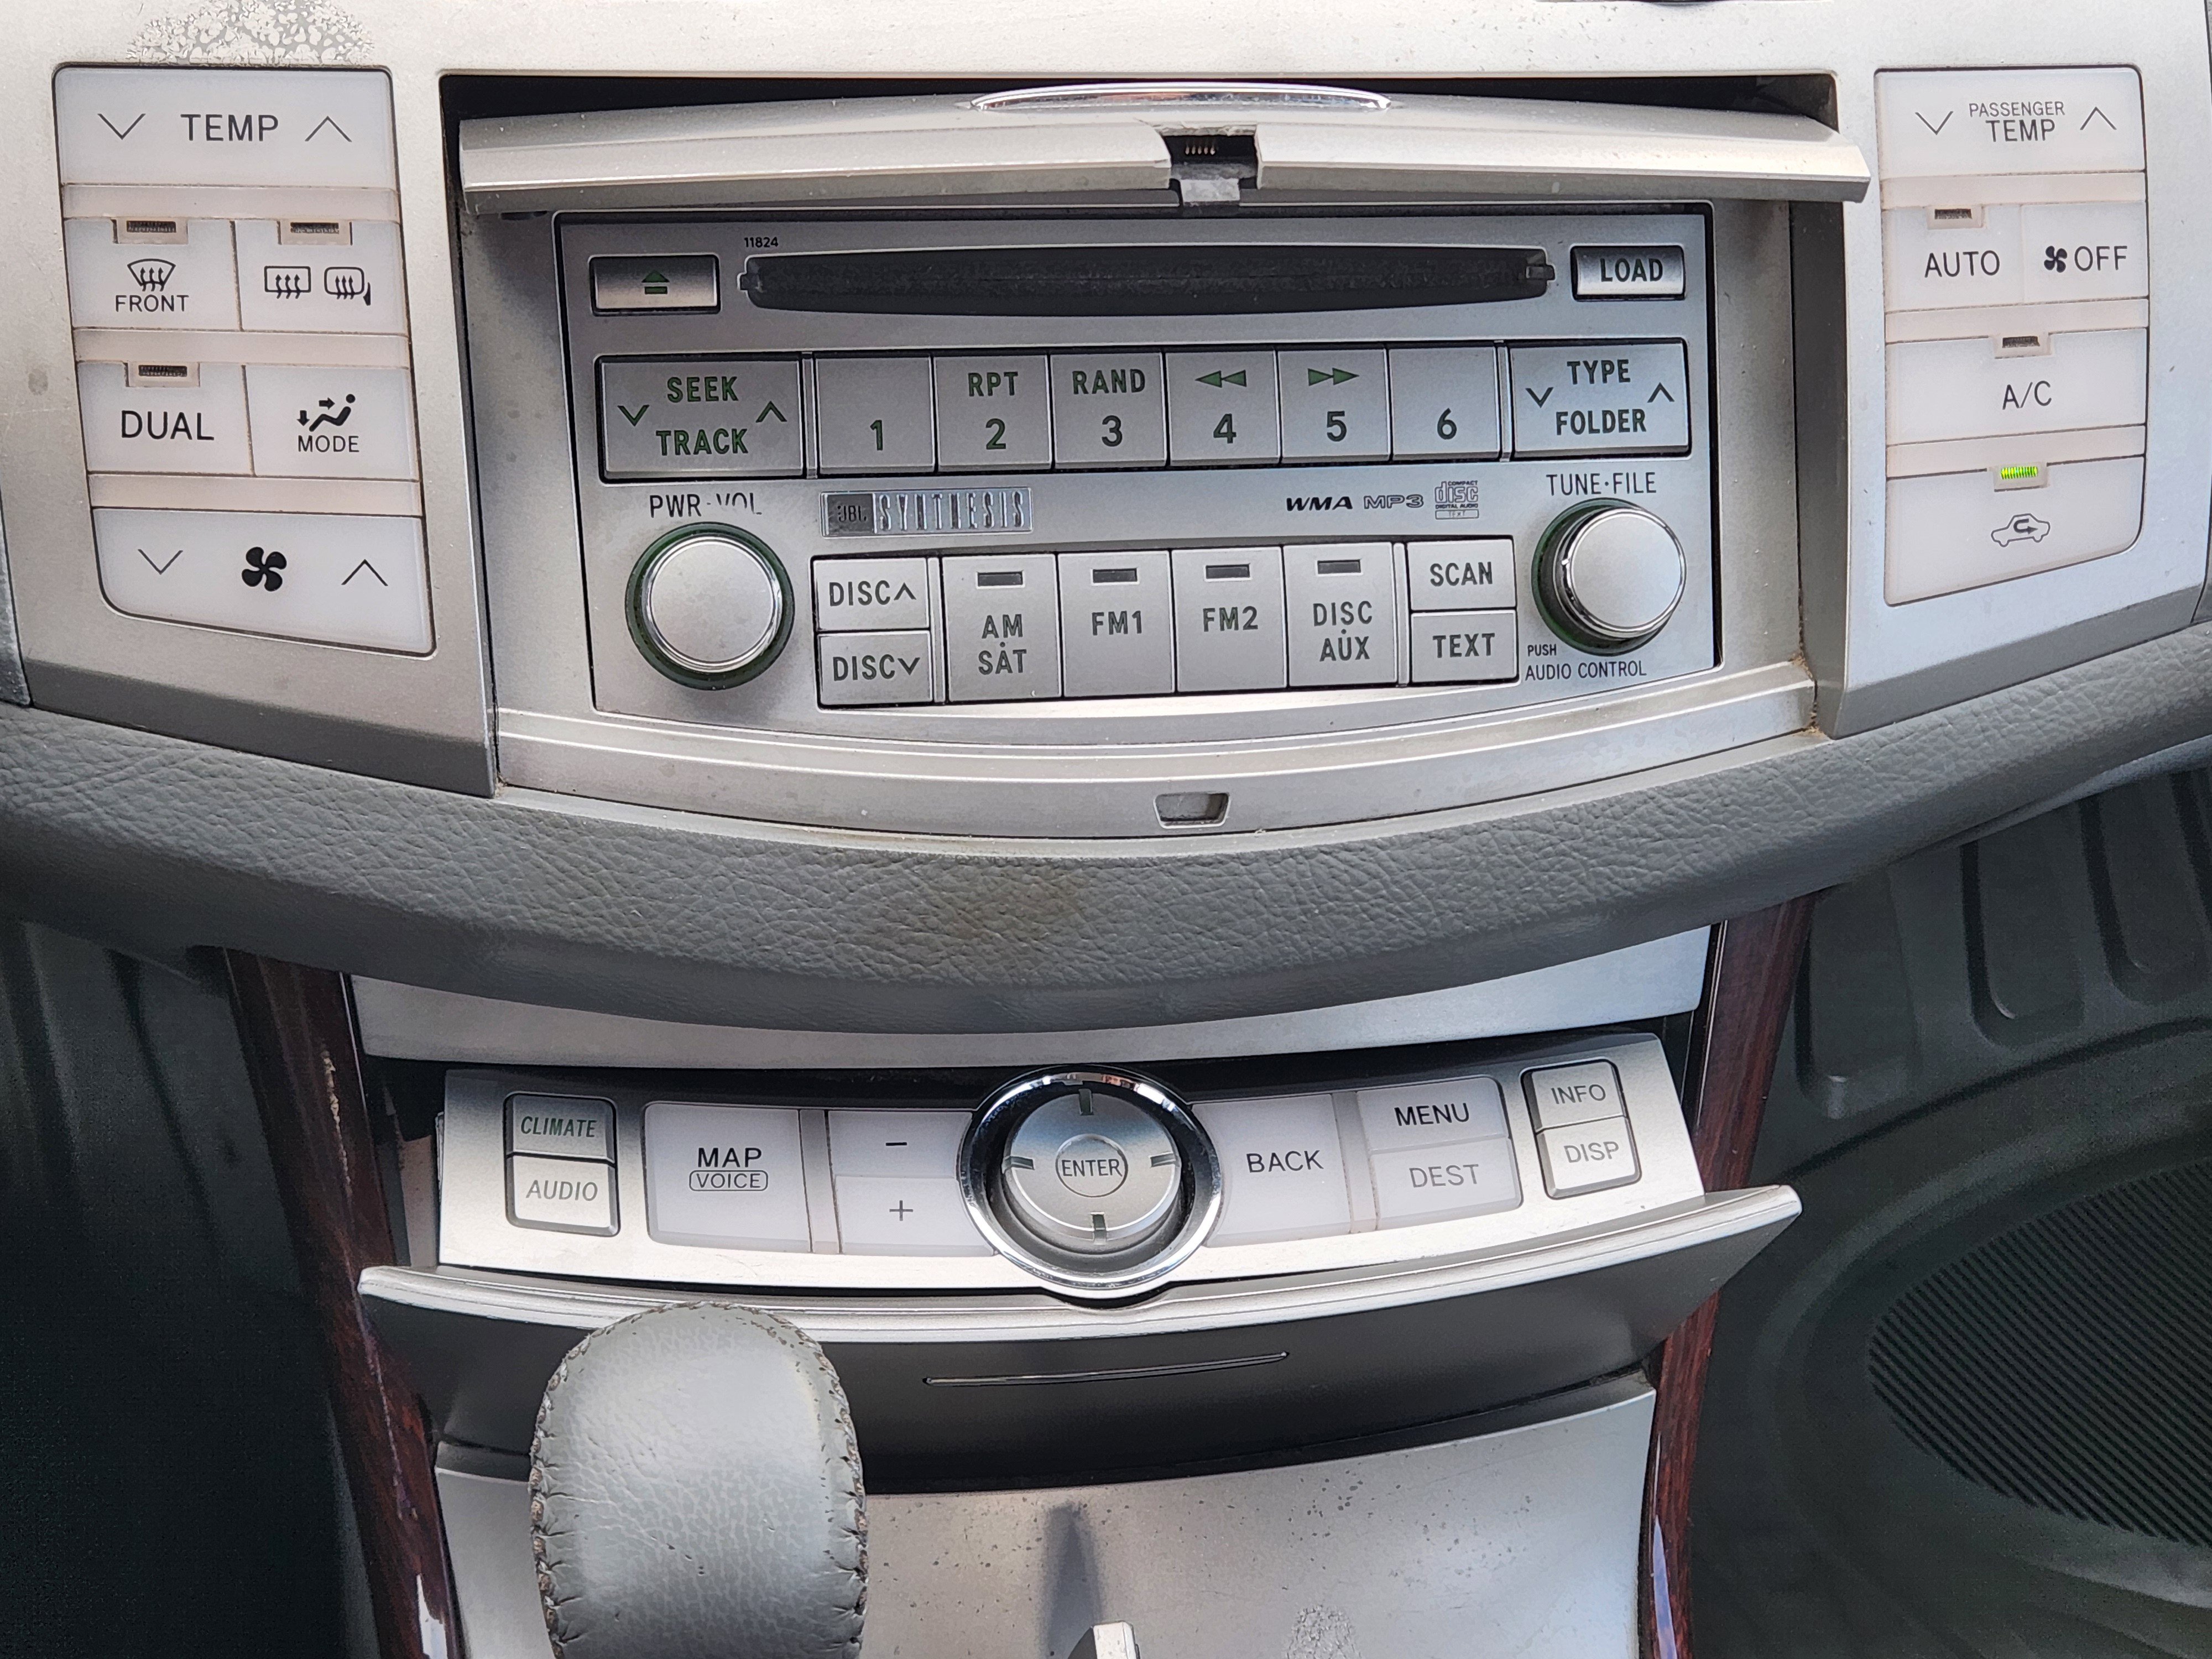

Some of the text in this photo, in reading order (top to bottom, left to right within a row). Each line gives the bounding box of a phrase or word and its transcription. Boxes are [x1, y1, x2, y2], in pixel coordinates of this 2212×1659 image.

[1969, 101, 2065, 118] PASSENGER
[181, 113, 279, 142] TEMP
[1985, 119, 2056, 142] TEMP
[744, 237, 779, 248] 11824
[1600, 258, 1664, 283] LOAD
[1924, 250, 2000, 278] AUTO
[2074, 246, 2127, 272] OFF
[114, 294, 190, 312] FRONT
[968, 372, 1018, 397] RPT
[1072, 369, 1146, 395] RAND
[1567, 359, 1631, 385] TYPE
[667, 376, 739, 403] SEEK
[2002, 380, 2052, 410] A/C
[121, 410, 215, 441] DUAL
[985, 418, 1006, 450] 2
[1101, 415, 1123, 447] 3
[1212, 413, 1237, 444] 4
[1326, 411, 1347, 442] 5
[1437, 408, 1457, 440] 6
[1556, 408, 1647, 436] FOLDER
[298, 435, 360, 453] MODE
[656, 429, 748, 456] TRACK
[870, 420, 884, 451] 1
[837, 491, 1025, 531] JBL SYNTHESIS
[1286, 494, 1424, 512] WMA MP3
[1430, 562, 1493, 587] SCAN
[830, 582, 890, 607] DISC
[981, 613, 1023, 639] AM
[1092, 611, 1142, 636] FM1
[1202, 606, 1259, 632] FM2
[1313, 601, 1373, 627] DISC
[1319, 636, 1370, 662] AUX
[1432, 633, 1495, 659] TEXT
[1527, 644, 1557, 657] PUSH
[832, 655, 896, 681] DISC
[978, 649, 1027, 675] SAT
[1525, 660, 1647, 681] AUDIO CONTROL
[1551, 1083, 1606, 1105] INFO
[520, 1116, 597, 1138] CLIMATE
[1394, 1102, 1470, 1126] MENU
[697, 1147, 763, 1168] MAP
[1246, 1150, 1324, 1173] BACK
[1563, 1141, 1620, 1163] DISP
[696, 1173, 762, 1189] VOICE
[1062, 1159, 1123, 1177] ENTER
[1409, 1164, 1479, 1188] DEST
[526, 1180, 598, 1202] AUDIO
